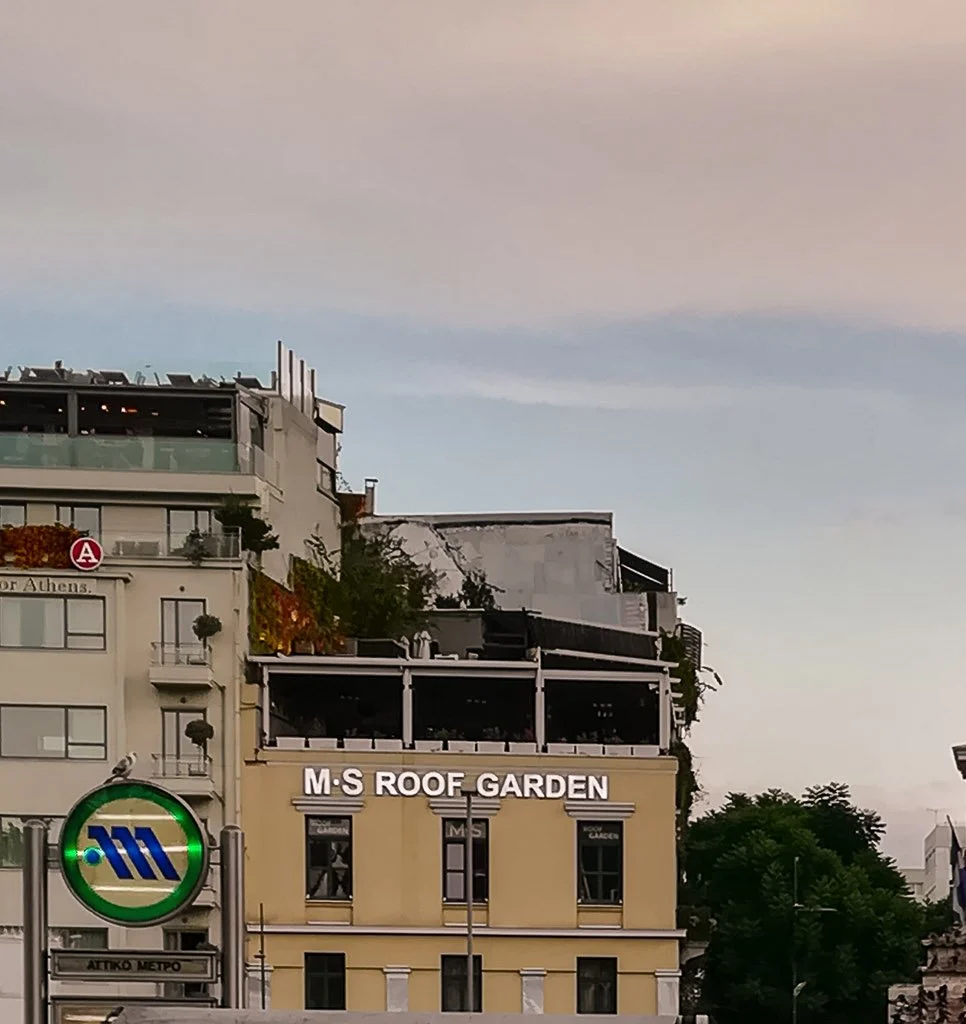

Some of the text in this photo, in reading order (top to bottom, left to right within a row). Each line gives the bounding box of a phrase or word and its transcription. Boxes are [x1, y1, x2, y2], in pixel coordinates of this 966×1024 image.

[75, 541, 99, 563] A
[23, 578, 92, 594] Athens.
[375, 770, 465, 797] ROOF
[476, 772, 609, 800] GARDEN
[137, 960, 182, 972] ΜΕΤΡΟ
